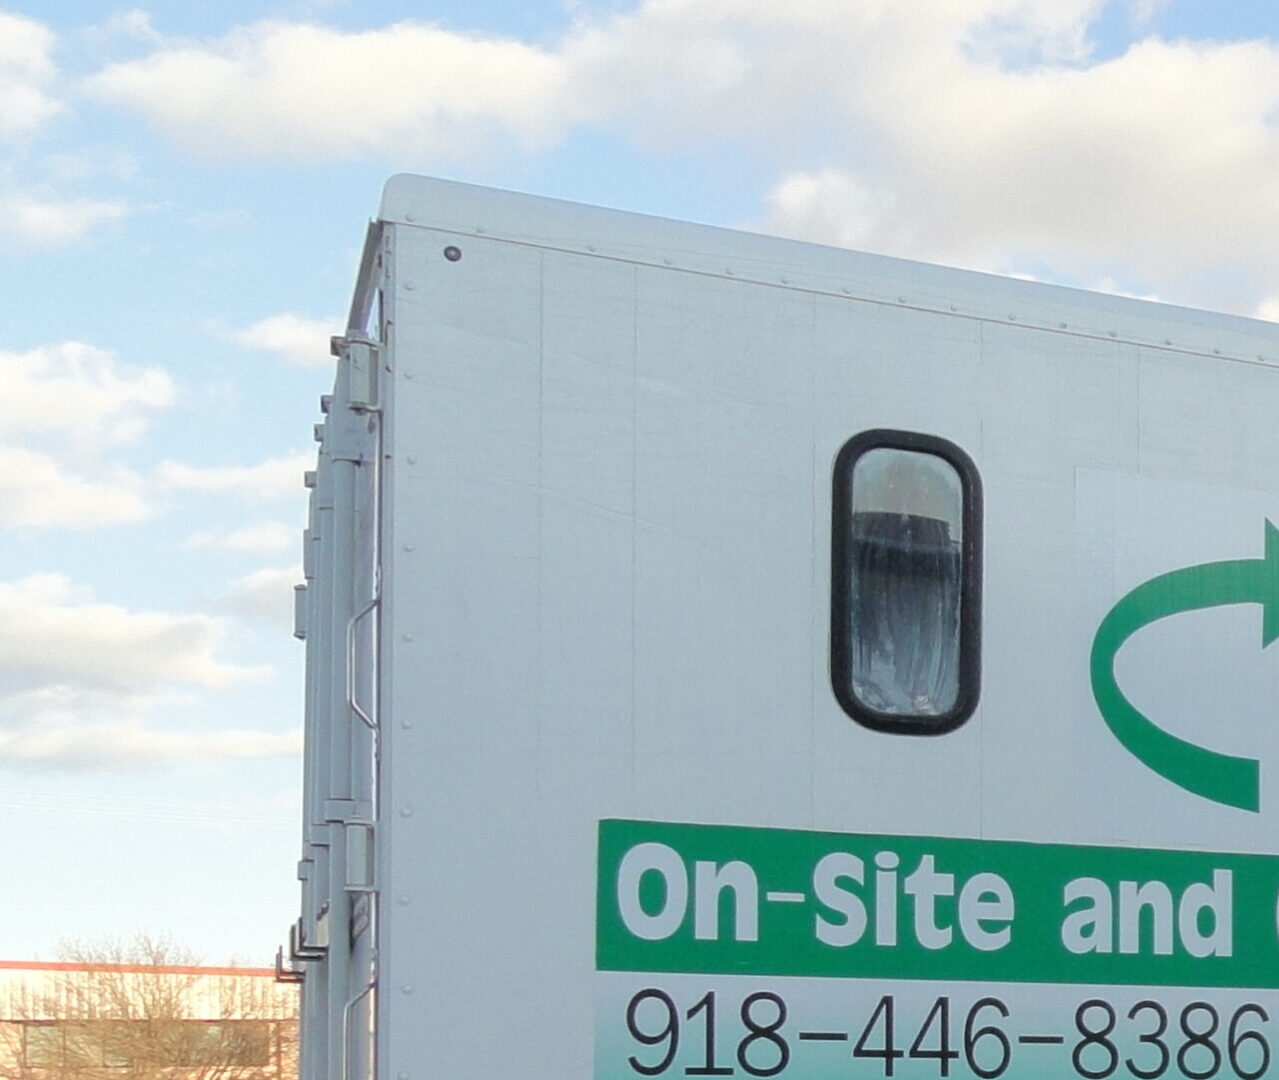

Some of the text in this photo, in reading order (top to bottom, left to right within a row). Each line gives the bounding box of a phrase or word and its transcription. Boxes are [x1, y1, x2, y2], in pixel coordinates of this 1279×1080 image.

[616, 841, 1015, 951] On-Site
[1061, 868, 1233, 958] and
[625, 988, 1271, 1080] 918-446-8386
